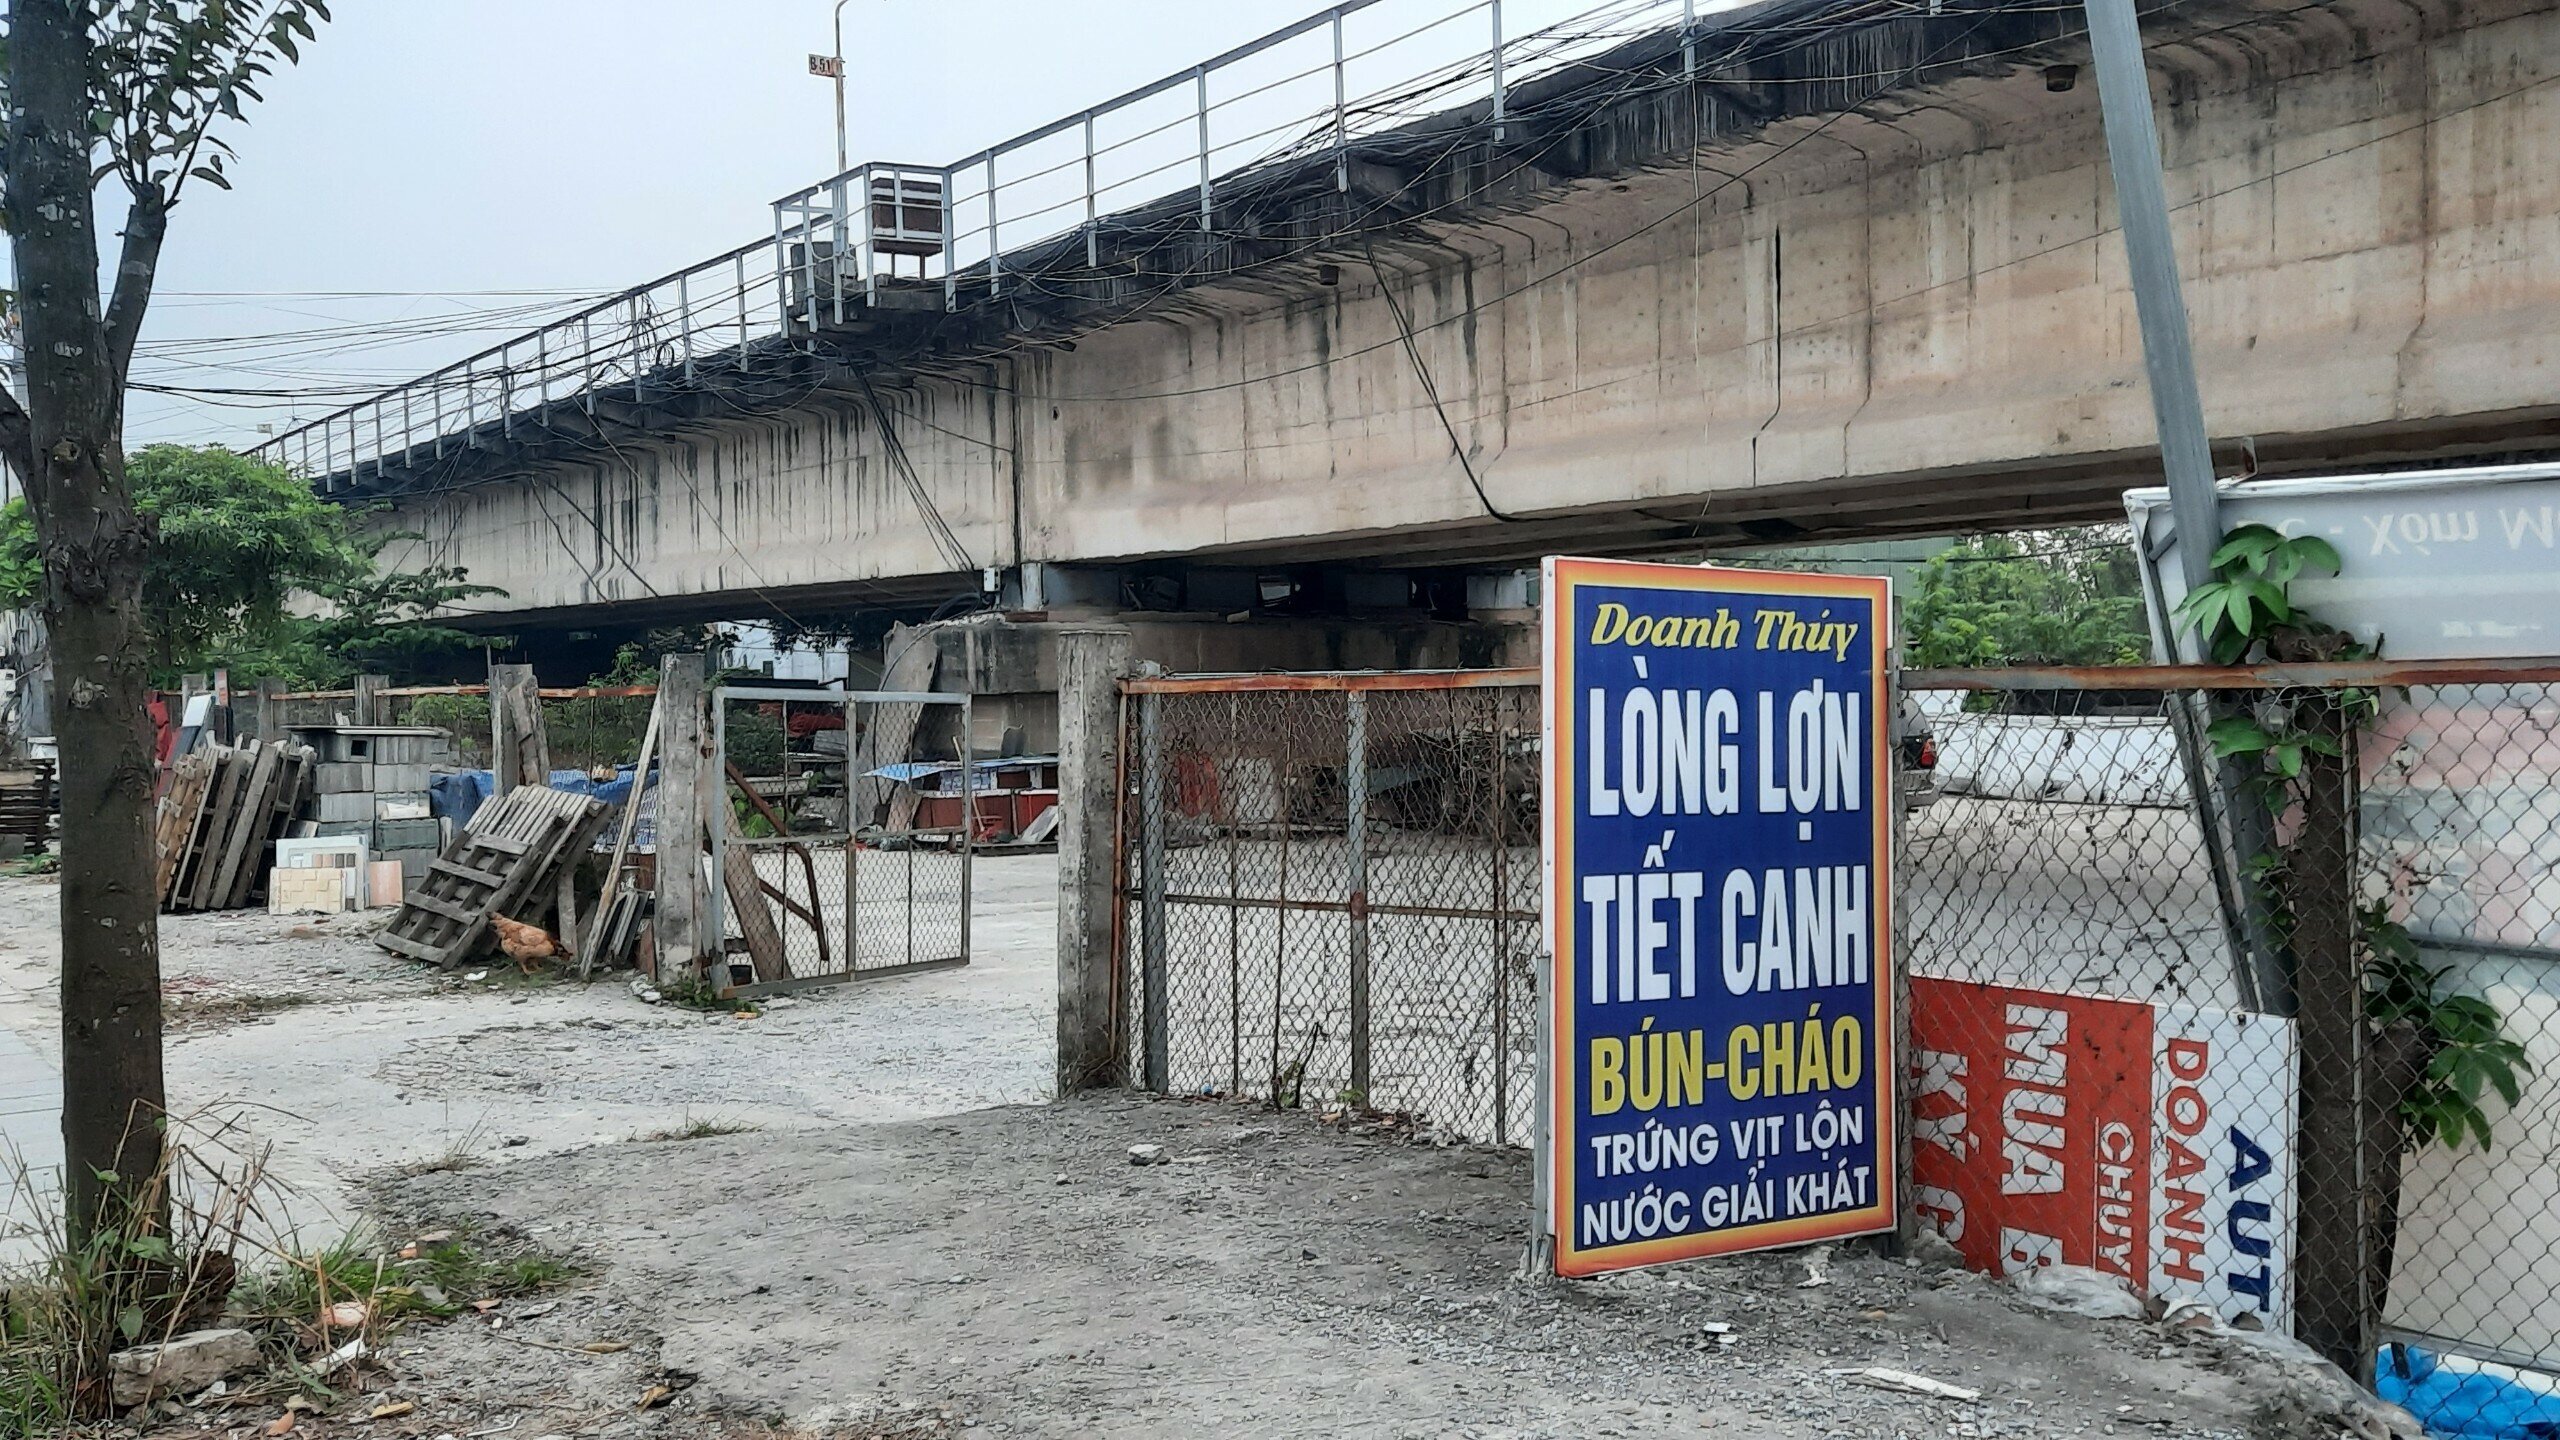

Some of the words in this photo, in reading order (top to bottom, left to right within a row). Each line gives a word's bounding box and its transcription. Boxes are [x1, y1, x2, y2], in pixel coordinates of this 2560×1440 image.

[1591, 603, 1741, 650] Doanh
[1754, 609, 1859, 663] Thúy
[1589, 655, 1739, 817] LÒNG
[1759, 678, 1860, 841] LỢN
[1583, 830, 1703, 1004] TIẾT
[1721, 864, 1869, 996] CANH
[1590, 1002, 1862, 1116] BÚN-CHÁO
[1911, 1050, 1980, 1163] KÝ
[2001, 1003, 2069, 1195] MUA
[1591, 1116, 1719, 1177] TRỨNG
[1730, 1115, 1785, 1169] VỊT
[1795, 1099, 1863, 1160] LỘN
[2163, 1037, 2208, 1283] DOANH
[1583, 1183, 1691, 1246] NƯỚC
[1702, 1166, 1774, 1229] GIẢI
[1787, 1156, 1870, 1216] KHÁT
